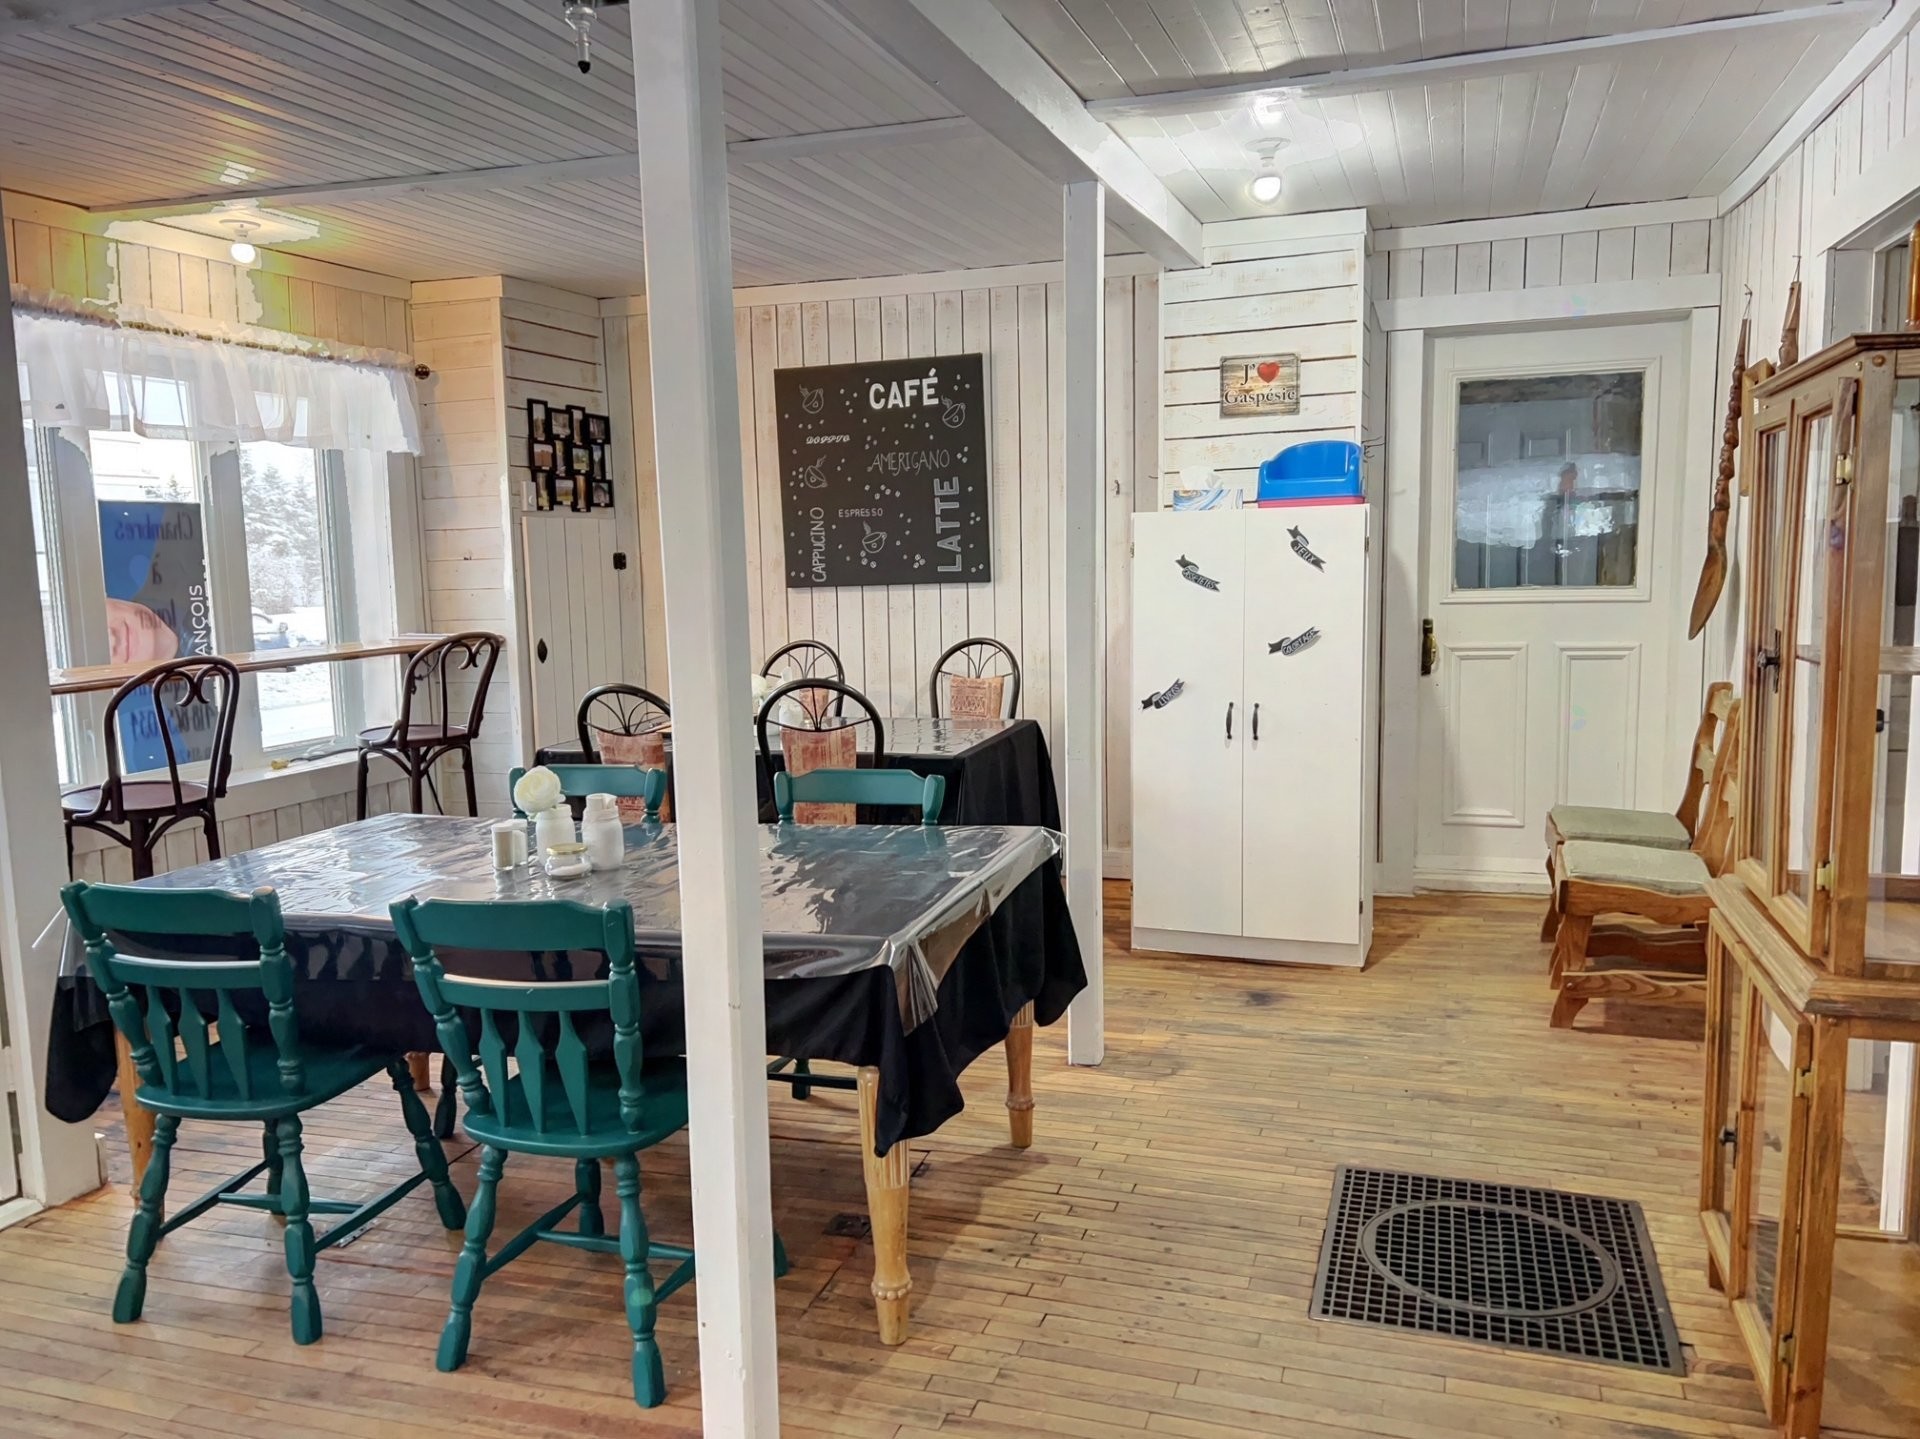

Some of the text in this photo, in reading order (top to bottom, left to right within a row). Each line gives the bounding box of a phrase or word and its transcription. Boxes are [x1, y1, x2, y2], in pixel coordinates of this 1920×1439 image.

[869, 367, 939, 409] CAFÉ
[1224, 388, 1296, 407] Gaspésie
[867, 449, 950, 475] AMERICANO
[838, 508, 883, 518] ESPRESSO
[934, 476, 962, 572] LATTE
[810, 506, 827, 583] CAPPUCINO
[1293, 543, 1316, 563] JEUX
[189, 584, 207, 657] ANÇOIS
[1158, 683, 1181, 706] LIVRES
